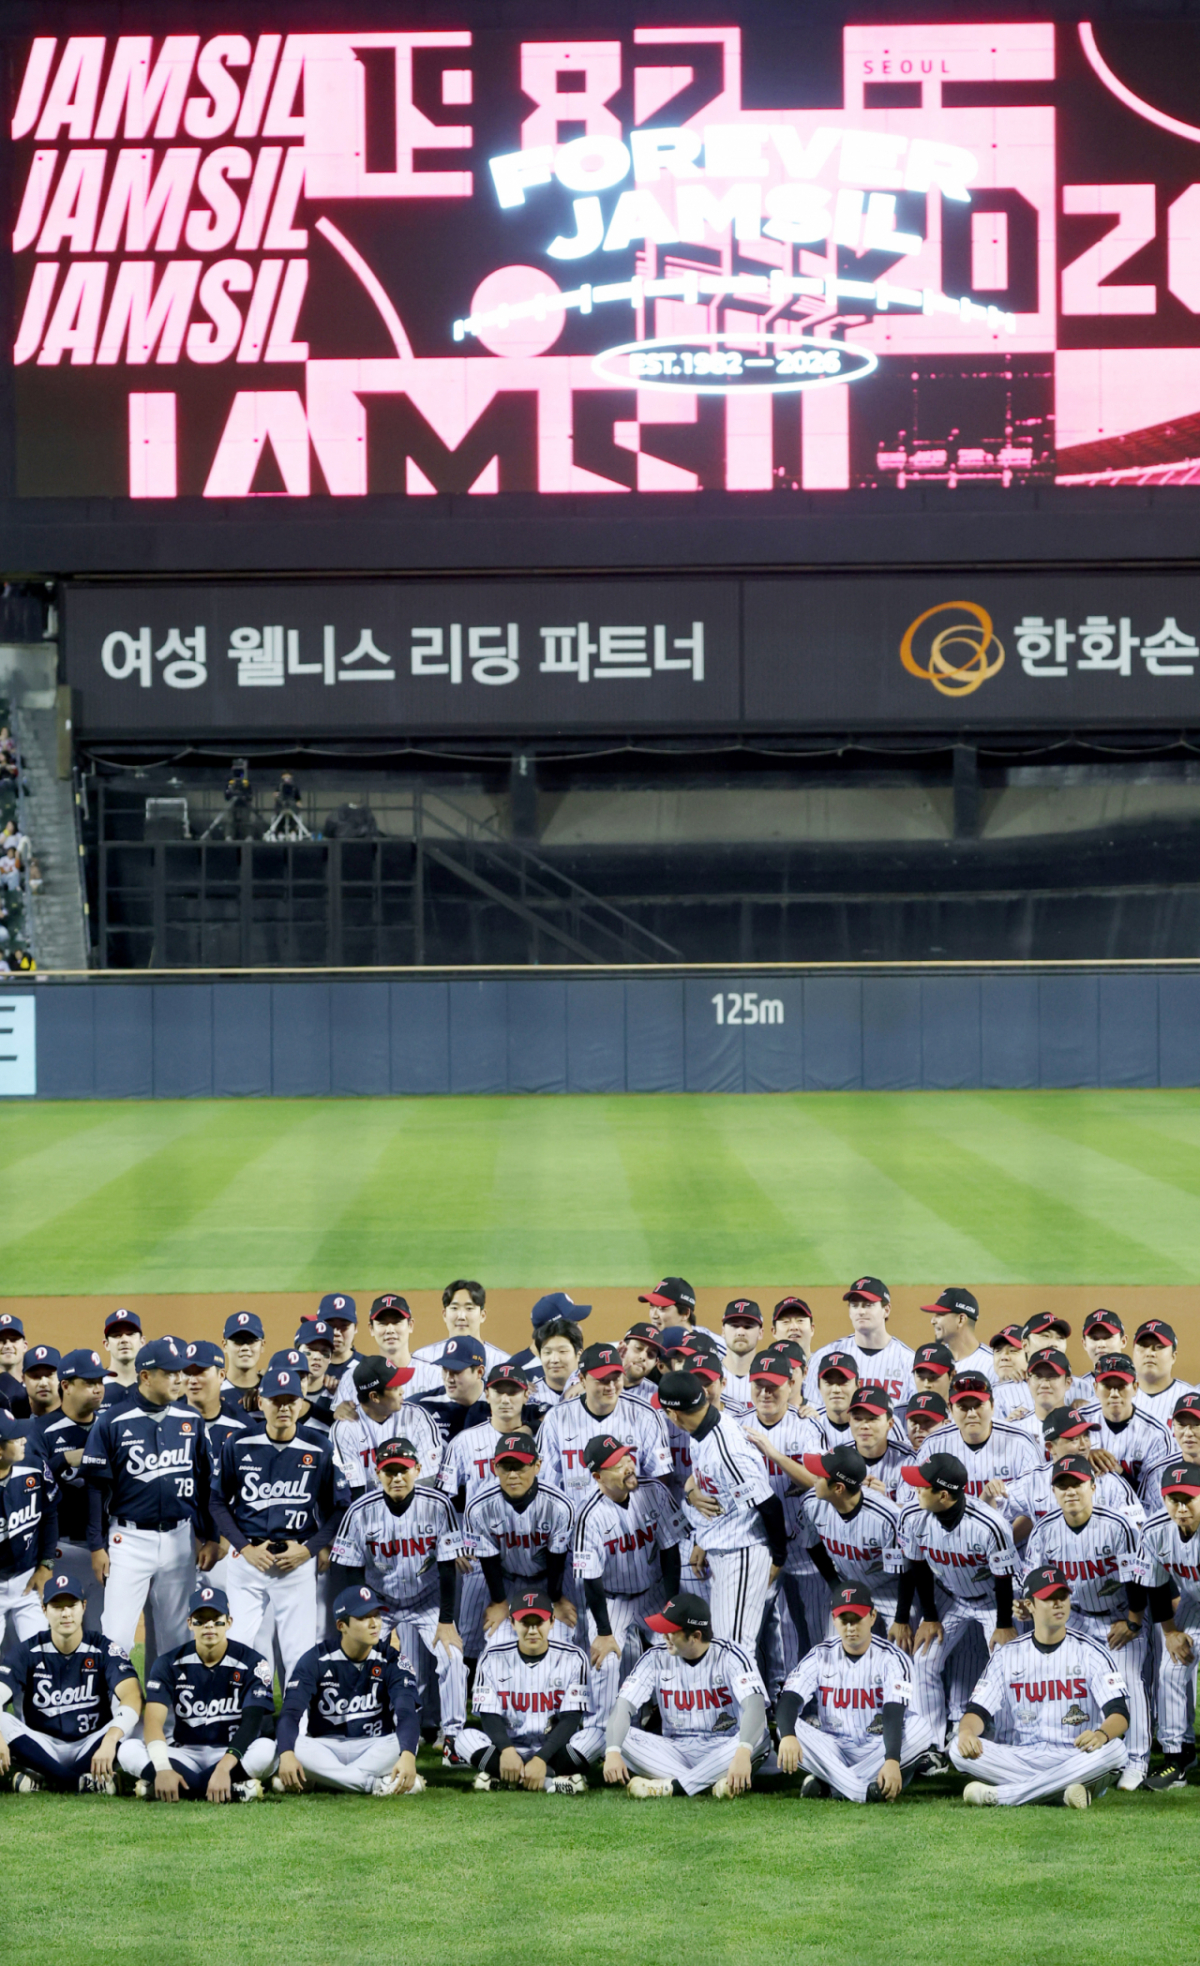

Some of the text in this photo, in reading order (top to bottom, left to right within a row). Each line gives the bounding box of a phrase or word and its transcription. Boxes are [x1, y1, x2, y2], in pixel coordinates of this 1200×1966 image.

[863, 60, 950, 75] SEOUL
[12, 34, 308, 140] JAMSIL
[489, 123, 979, 209] FOREVER
[13, 146, 308, 252] JAMSIL
[546, 182, 923, 260] JAMSIL
[14, 258, 309, 365] JAMSIL
[775, 350, 841, 375] 2026
[101, 620, 704, 689] 여성 웰니스 리딩 파트너
[711, 992, 785, 1025] 125m
[856, 1278, 871, 1290] T
[333, 1296, 346, 1310] D
[381, 1295, 397, 1307] T
[735, 1301, 750, 1313] T
[116, 1308, 128, 1320] D
[237, 1312, 250, 1326] D
[1093, 1310, 1108, 1321] T
[315, 1321, 327, 1335] D
[646, 1327, 659, 1338] T
[1146, 1321, 1162, 1332] T
[35, 1346, 48, 1360] D
[186, 1343, 198, 1357] D
[599, 1349, 613, 1363] T
[922, 1348, 937, 1361] T
[1040, 1349, 1056, 1360] T
[287, 1350, 300, 1365] D
[693, 1355, 708, 1367] T
[760, 1357, 775, 1371] T
[829, 1353, 844, 1365] T
[499, 1365, 515, 1377] T
[277, 1371, 290, 1387] D
[859, 1390, 875, 1403] T
[917, 1395, 932, 1408] T
[1183, 1395, 1199, 1407] T
[1069, 1410, 1082, 1422] T
[505, 1437, 521, 1450] T
[603, 1437, 617, 1449] T
[785, 1441, 799, 1452] LG
[126, 1437, 193, 1478] Seoul
[1060, 1458, 1075, 1471] T
[993, 1465, 1010, 1477] LG
[1171, 1469, 1188, 1483] T
[174, 1477, 195, 1498] 78
[240, 1470, 312, 1504] Seoul
[284, 1508, 308, 1530] 70
[417, 1524, 434, 1536] LG
[366, 1535, 438, 1558] TWINS
[819, 1534, 882, 1562] TWINS
[862, 1536, 878, 1547] LG
[967, 1542, 981, 1552] LG
[919, 1545, 989, 1567] TWINS
[1095, 1545, 1112, 1557] LG
[56, 1575, 69, 1588] D
[1042, 1569, 1056, 1583] T
[201, 1587, 214, 1602] D
[522, 1593, 538, 1607] T
[841, 1589, 856, 1602] T
[1066, 1665, 1082, 1676] LG
[548, 1677, 563, 1689] LG
[32, 1674, 100, 1709] Seoul
[819, 1685, 884, 1709] TWINS
[1010, 1678, 1088, 1703] TWINS
[175, 1687, 243, 1718] Seoul
[317, 1682, 383, 1717] Seoul
[497, 1689, 566, 1713] TWINS
[660, 1686, 733, 1711] TWINS
[77, 1712, 100, 1734] 37
